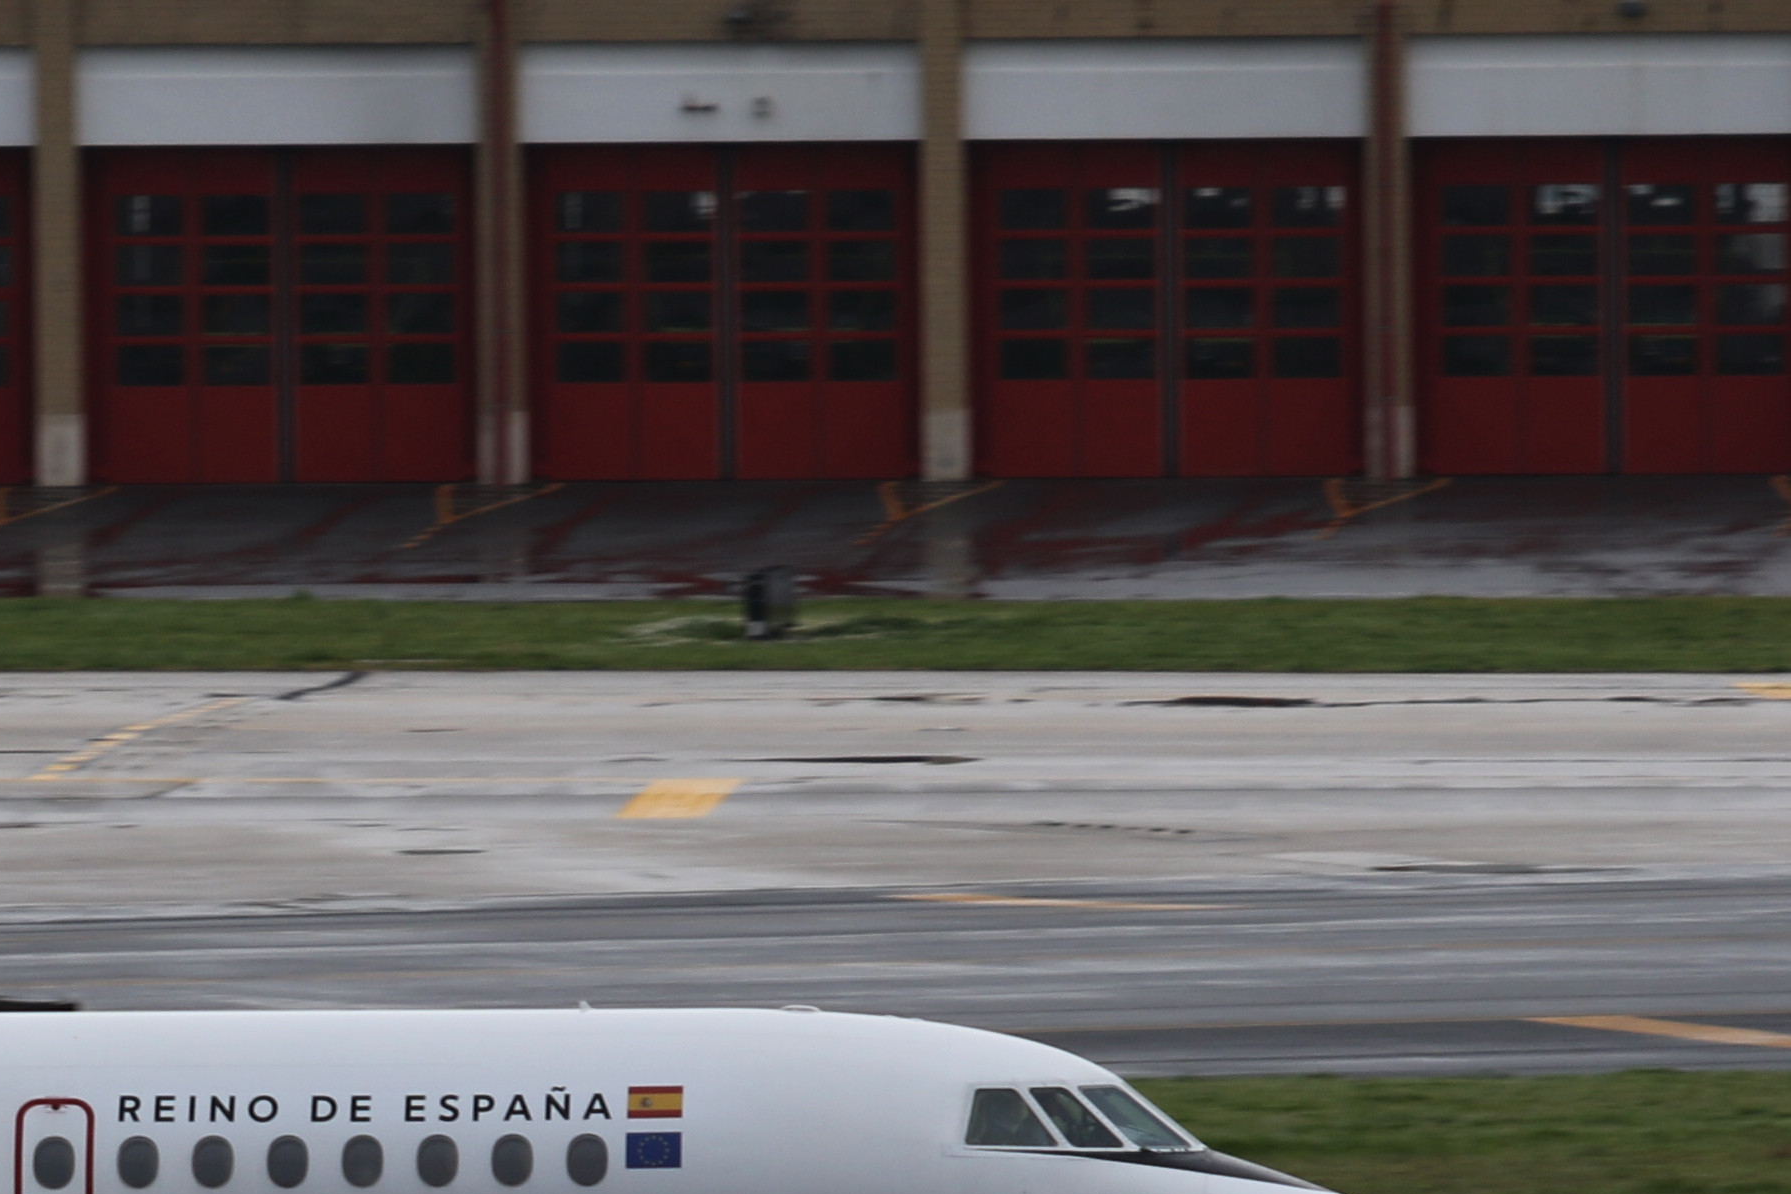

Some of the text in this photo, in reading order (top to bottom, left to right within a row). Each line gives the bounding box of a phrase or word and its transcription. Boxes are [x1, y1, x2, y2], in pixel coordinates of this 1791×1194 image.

[117, 1086, 612, 1123] REINO DE ESPAÑA
